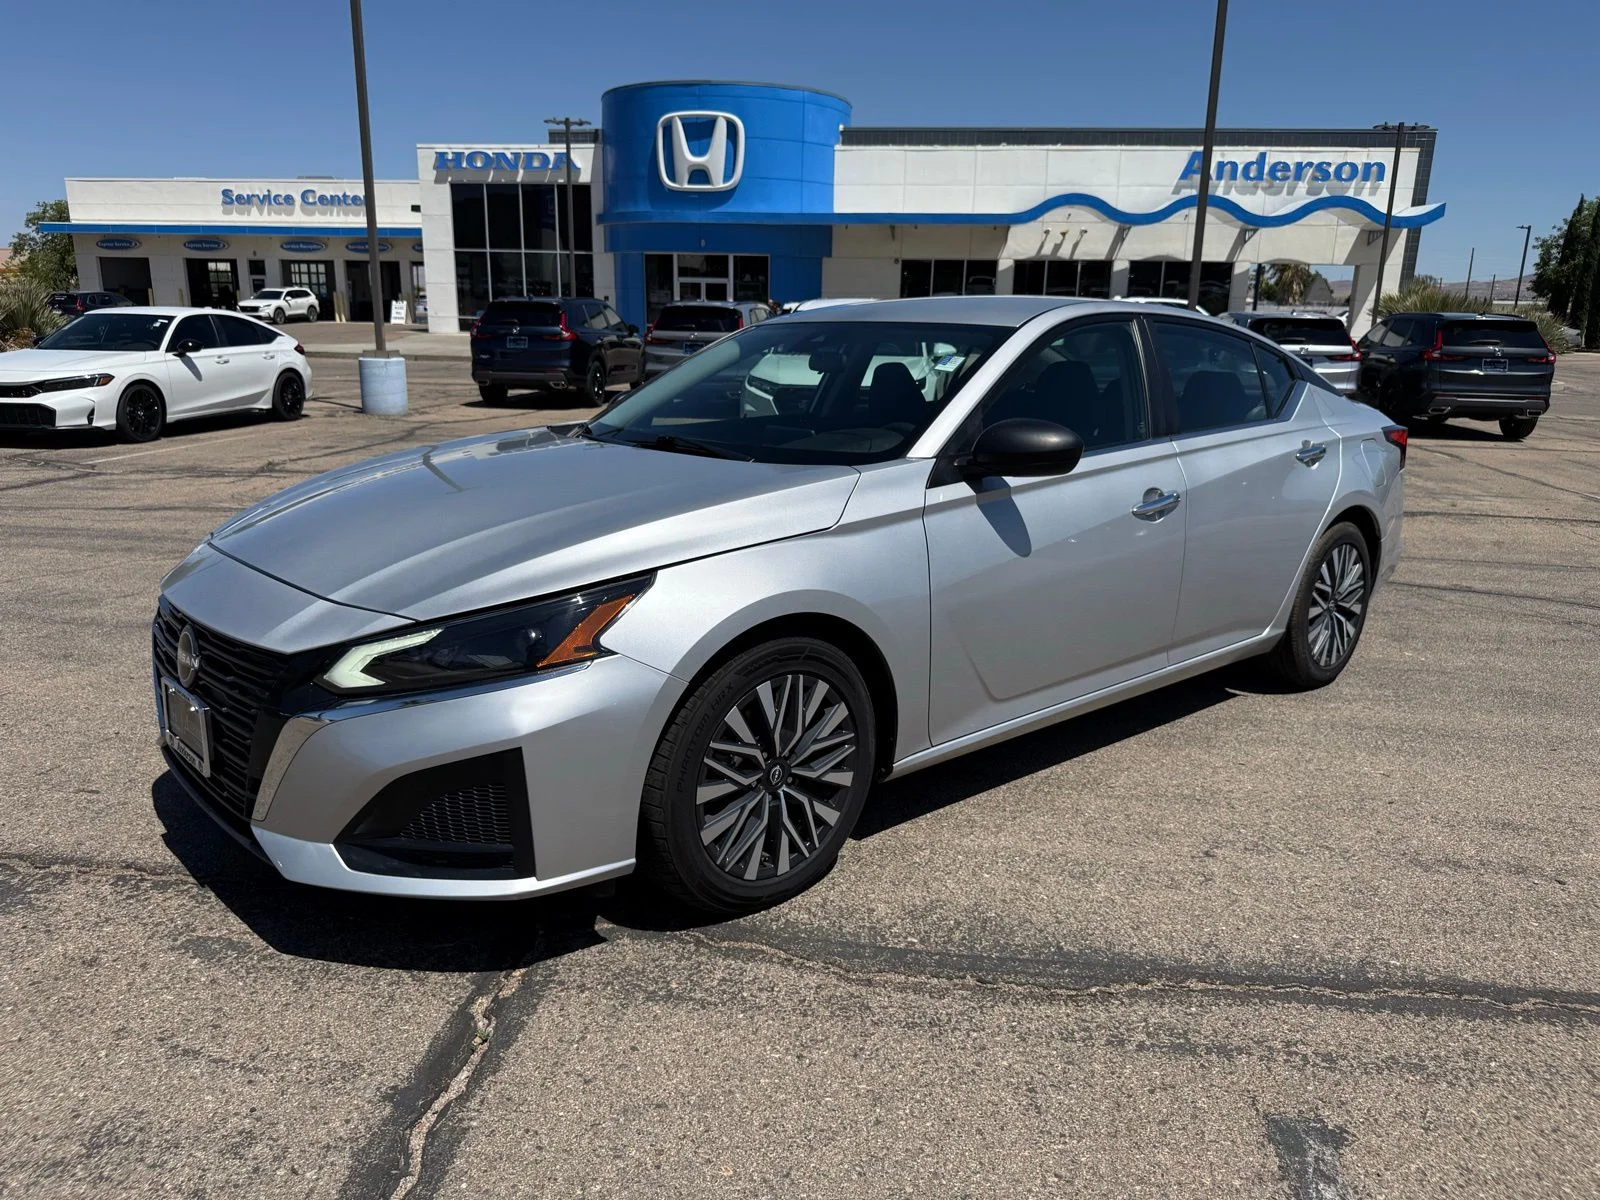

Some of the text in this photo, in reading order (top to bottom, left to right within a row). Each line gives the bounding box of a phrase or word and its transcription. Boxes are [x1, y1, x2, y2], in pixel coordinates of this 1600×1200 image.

[434, 151, 581, 170] HONDA
[1178, 151, 1386, 182] Anderson
[221, 188, 295, 206] Service
